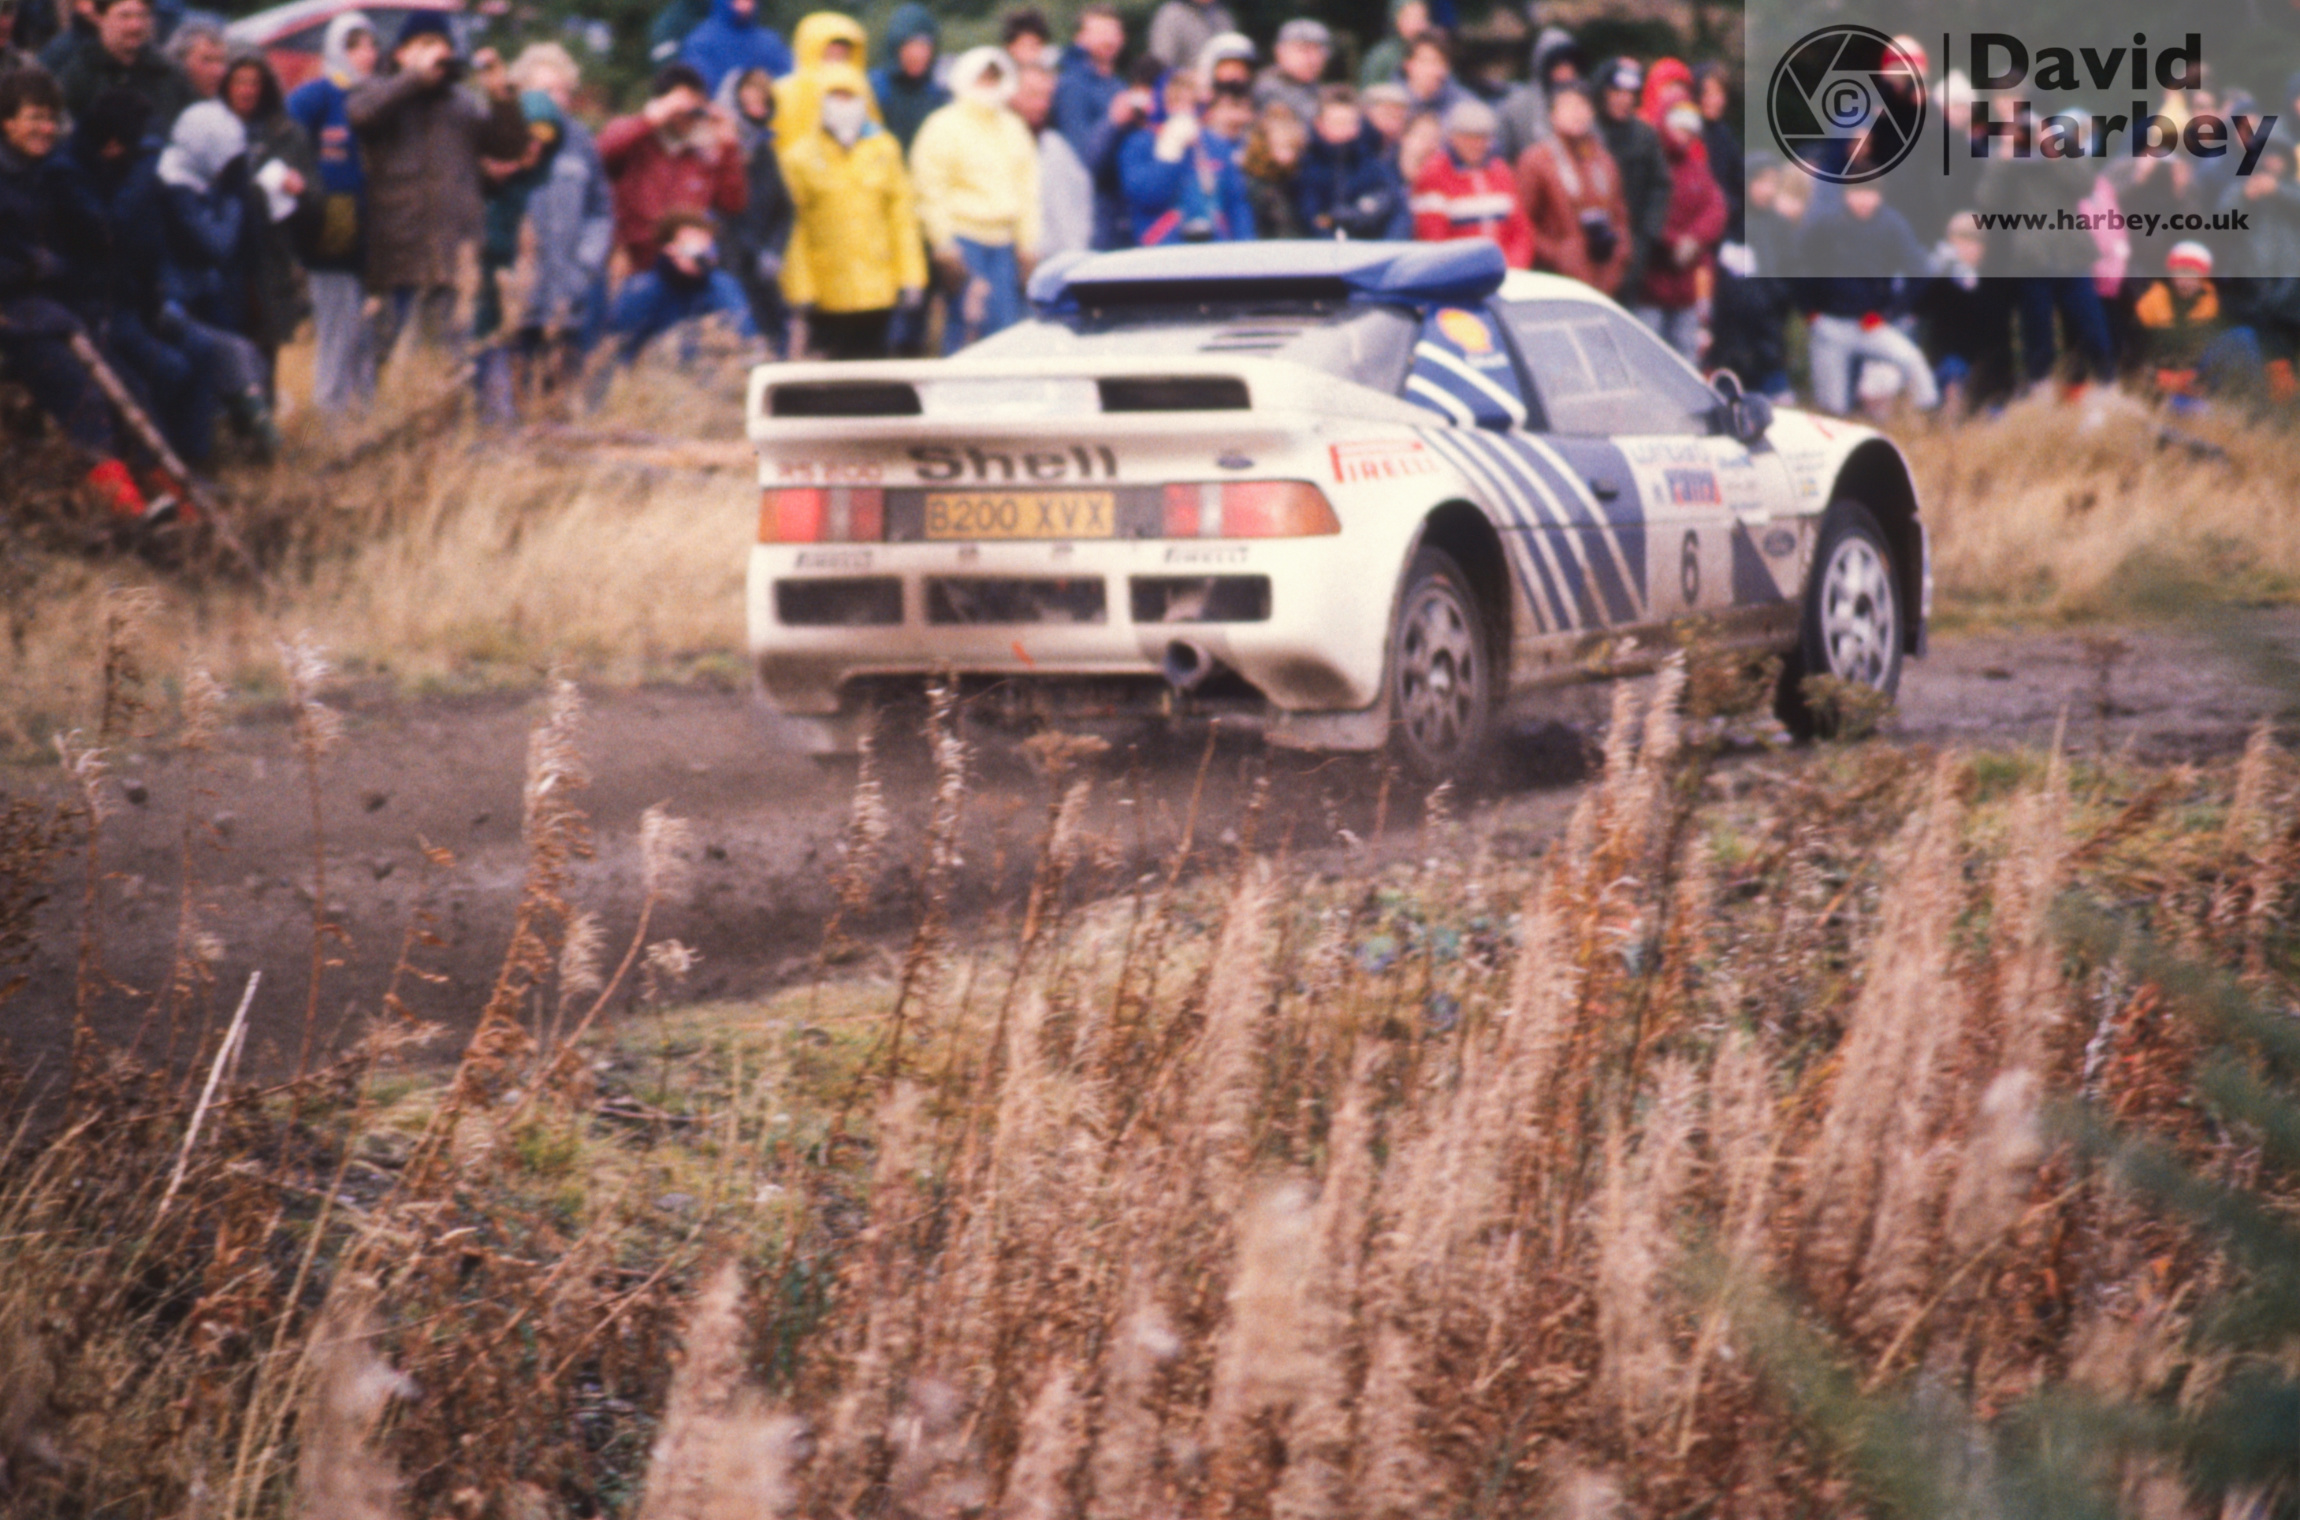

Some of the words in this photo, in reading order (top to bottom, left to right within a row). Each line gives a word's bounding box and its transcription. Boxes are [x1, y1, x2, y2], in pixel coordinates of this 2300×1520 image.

[907, 443, 1118, 481] Shell
[929, 499, 1019, 532] B200
[1034, 498, 1106, 531] XVX
[1681, 528, 1700, 607] 6
